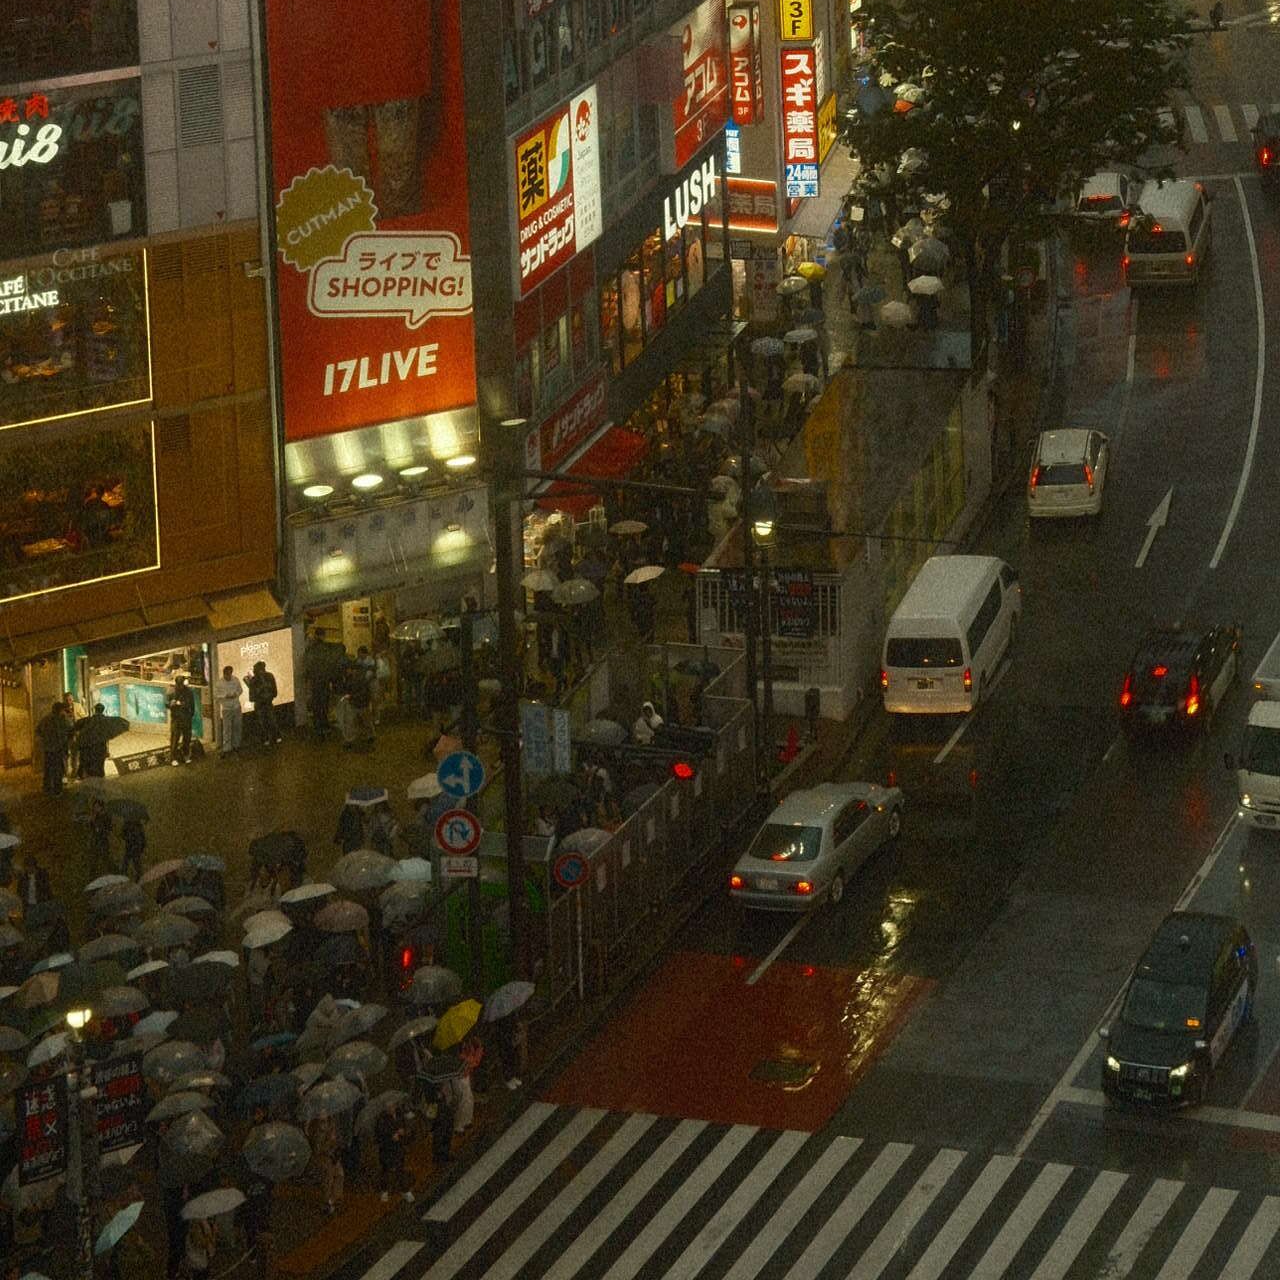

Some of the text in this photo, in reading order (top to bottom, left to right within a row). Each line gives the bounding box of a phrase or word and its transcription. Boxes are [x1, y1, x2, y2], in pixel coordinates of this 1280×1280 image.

[790, 2, 804, 36] 3F
[684, 52, 719, 118] アコム
[733, 57, 751, 102] アコム
[737, 106, 749, 116] 3F
[784, 53, 815, 160] スギ薬局
[520, 142, 545, 211] 薬
[663, 153, 716, 242] LUSH
[786, 182, 817, 197] 営業
[287, 192, 362, 245] CUTMAN
[359, 251, 441, 271] ライブで
[520, 214, 574, 280] サンドラッグ
[327, 276, 464, 298] SHOPPING!
[323, 342, 439, 397] 17LIVE
